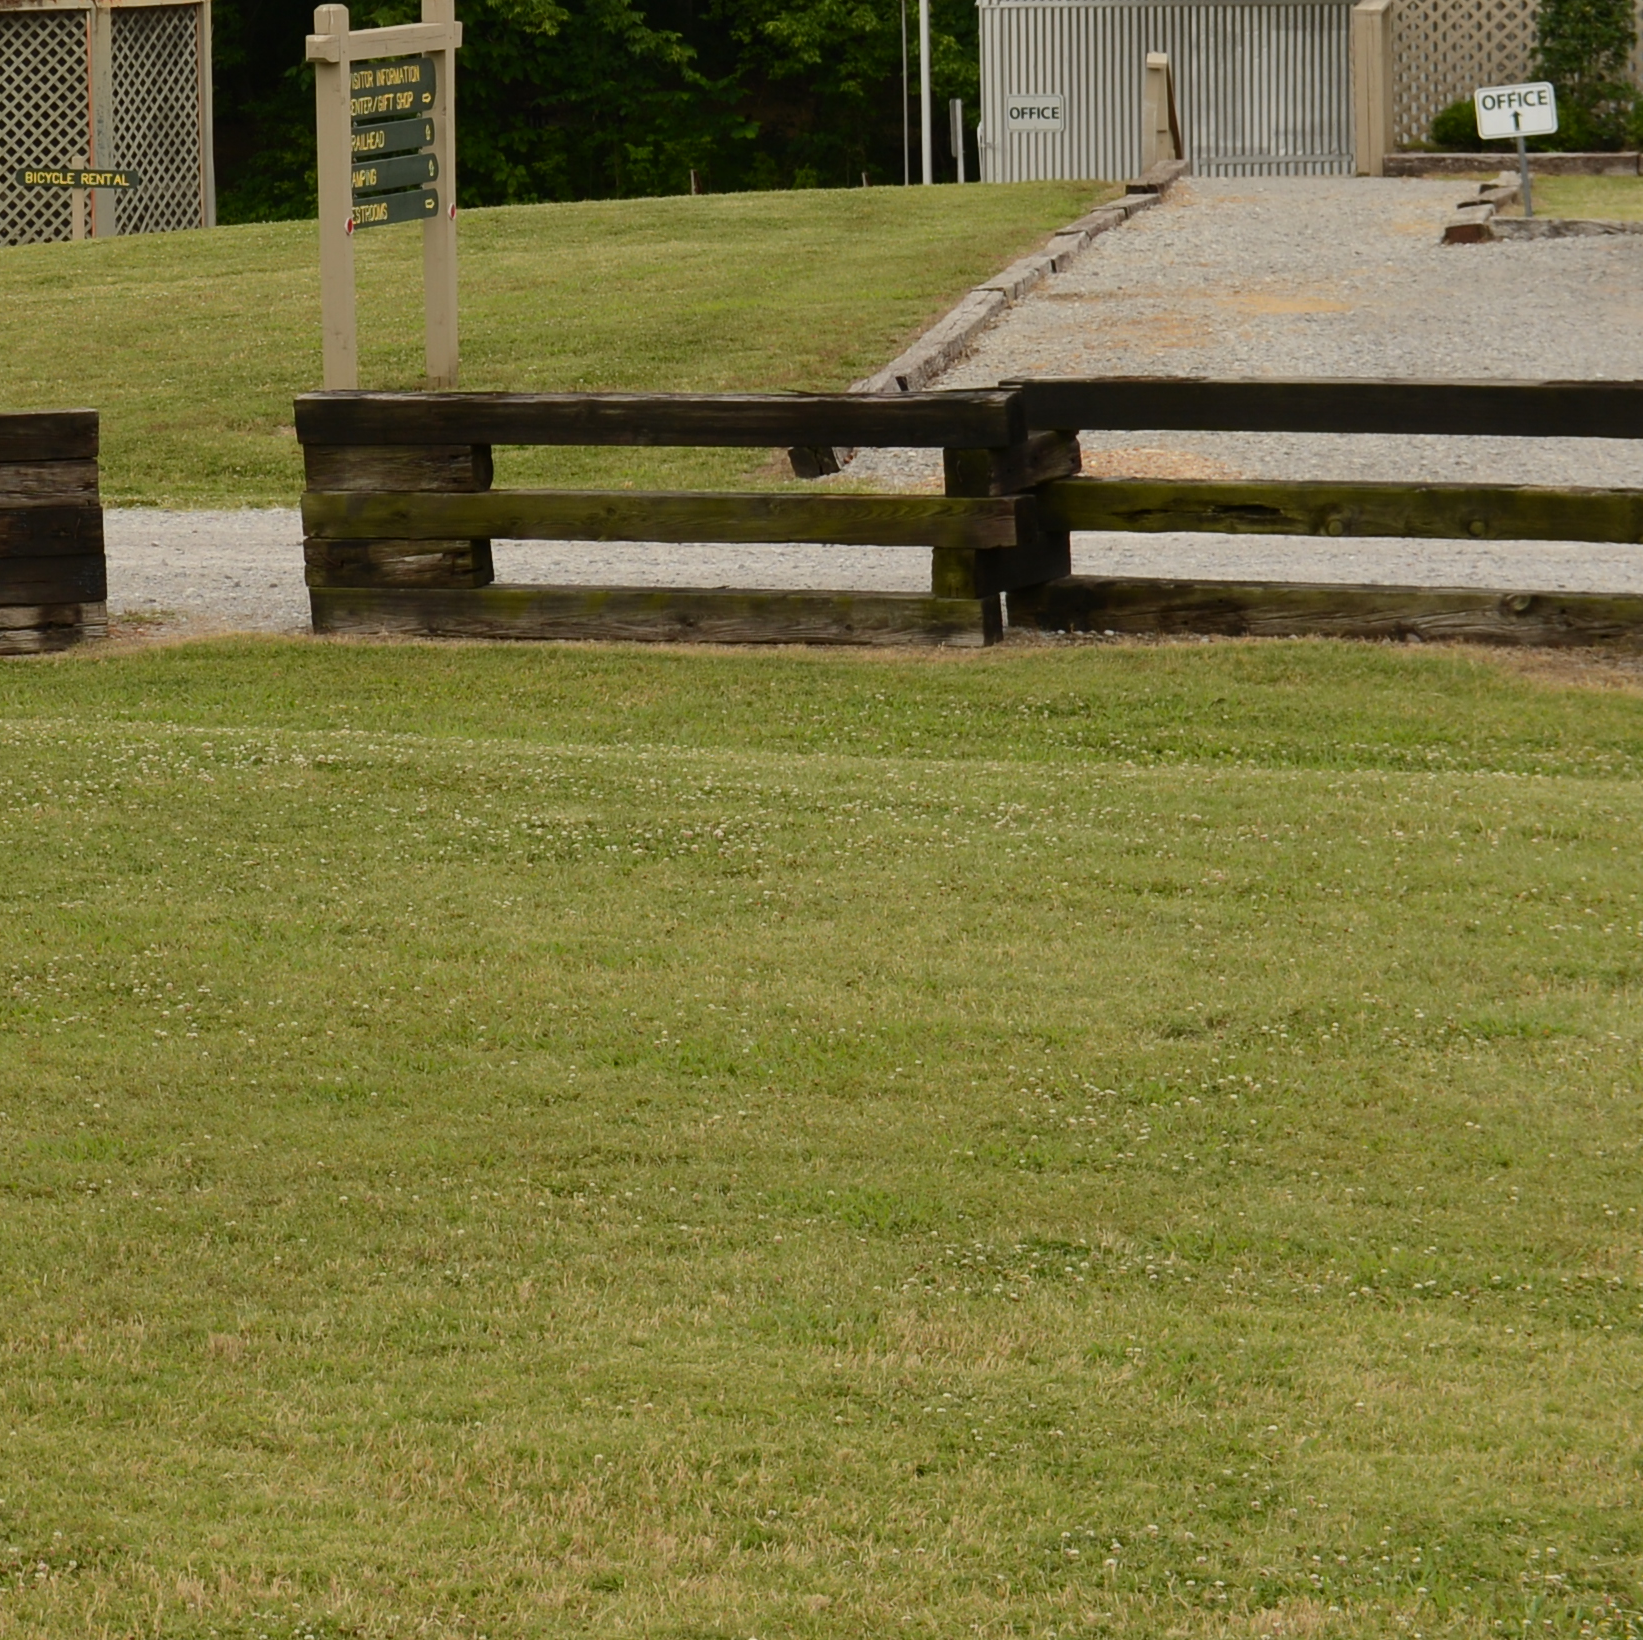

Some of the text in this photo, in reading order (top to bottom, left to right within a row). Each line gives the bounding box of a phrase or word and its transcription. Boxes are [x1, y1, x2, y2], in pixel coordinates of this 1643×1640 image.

[351, 65, 420, 90] ISITOR INFORMATION
[350, 91, 414, 116] ENTER/GIFT SHOP
[1481, 89, 1548, 111] OFFICE
[1009, 106, 1060, 120] OFFICE
[350, 130, 385, 152] RAILHEAD
[25, 171, 130, 187] BICYCLE RENTAL
[351, 168, 377, 188] AMPING
[351, 202, 388, 225] ESTROOMS
